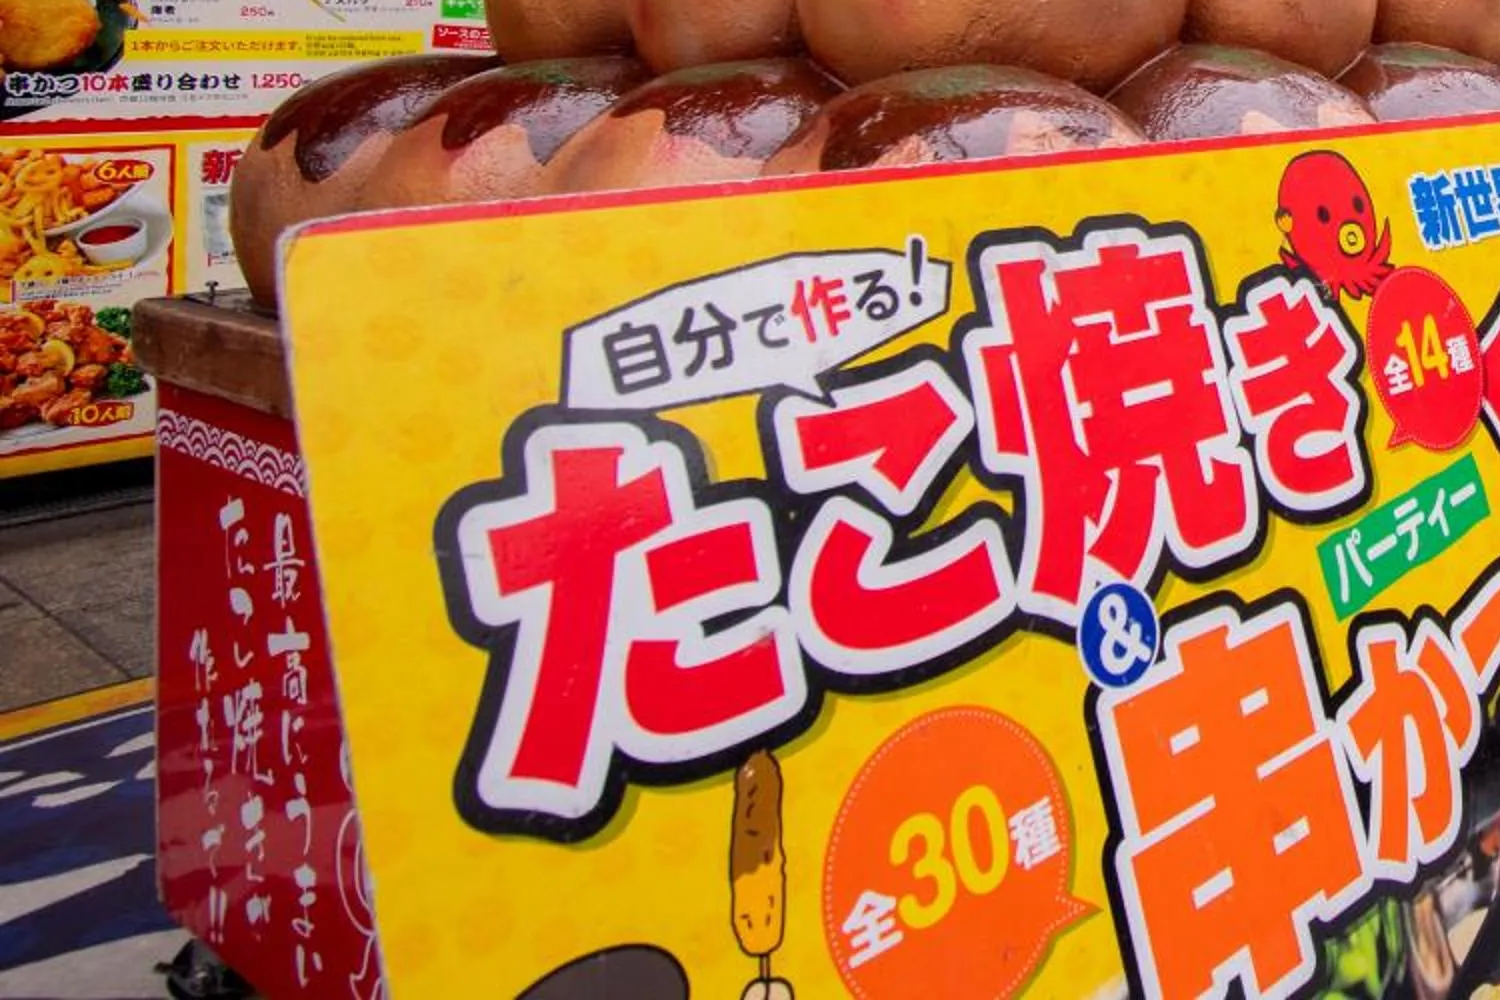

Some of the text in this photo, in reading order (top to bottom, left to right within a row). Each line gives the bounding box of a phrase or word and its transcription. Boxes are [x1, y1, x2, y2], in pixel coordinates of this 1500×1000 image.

[602, 236, 924, 396] 自分で作る!
[1384, 313, 1477, 397] 全14種
[457, 228, 1366, 818] たこ焼き
[1334, 482, 1476, 604] パーティー
[841, 782, 1064, 968] 全30種
